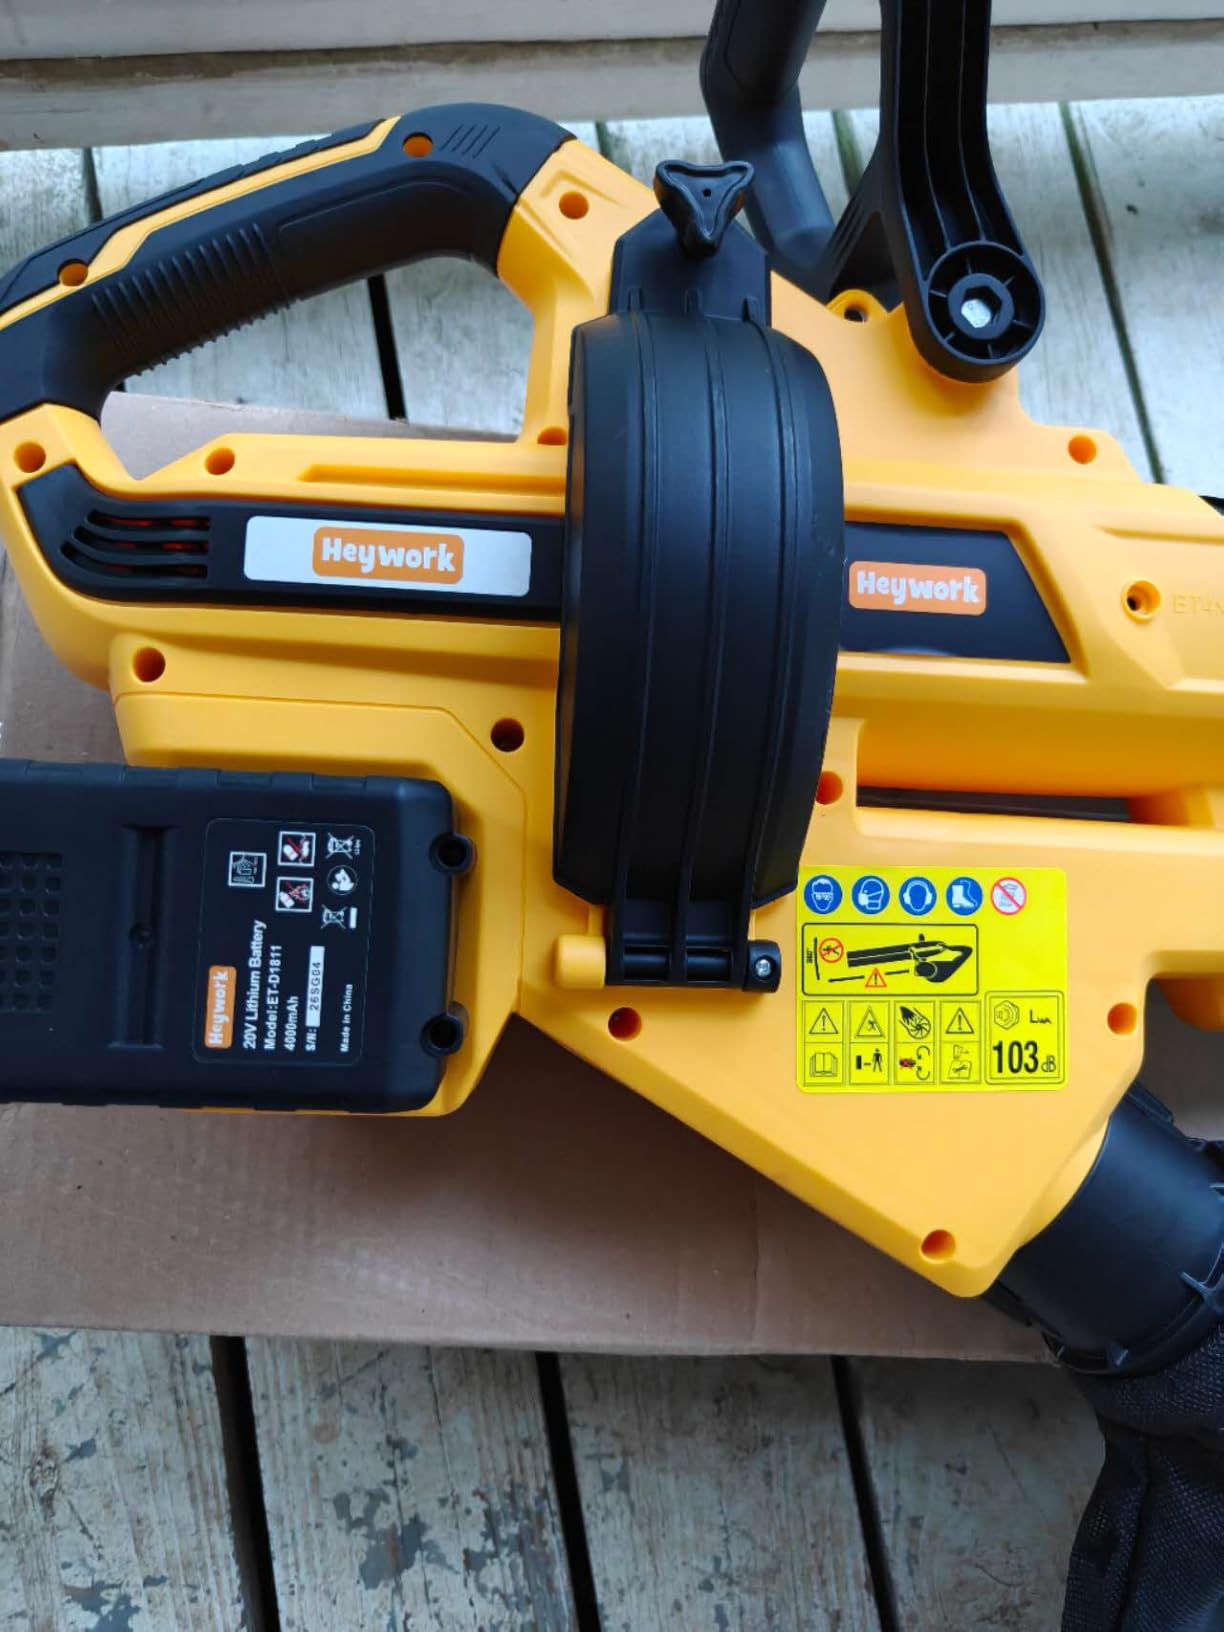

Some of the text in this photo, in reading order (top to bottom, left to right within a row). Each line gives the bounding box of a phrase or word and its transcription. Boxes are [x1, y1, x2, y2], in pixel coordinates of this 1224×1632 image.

[321, 536, 456, 574] Heywork
[856, 569, 980, 606] Heywork
[207, 970, 231, 1045] Heywork
[243, 919, 267, 1049] 20V Lithium Battery
[284, 996, 299, 1051] 4000mAh
[340, 984, 353, 1052] Made in China
[992, 1040, 1057, 1074] 103 dB
